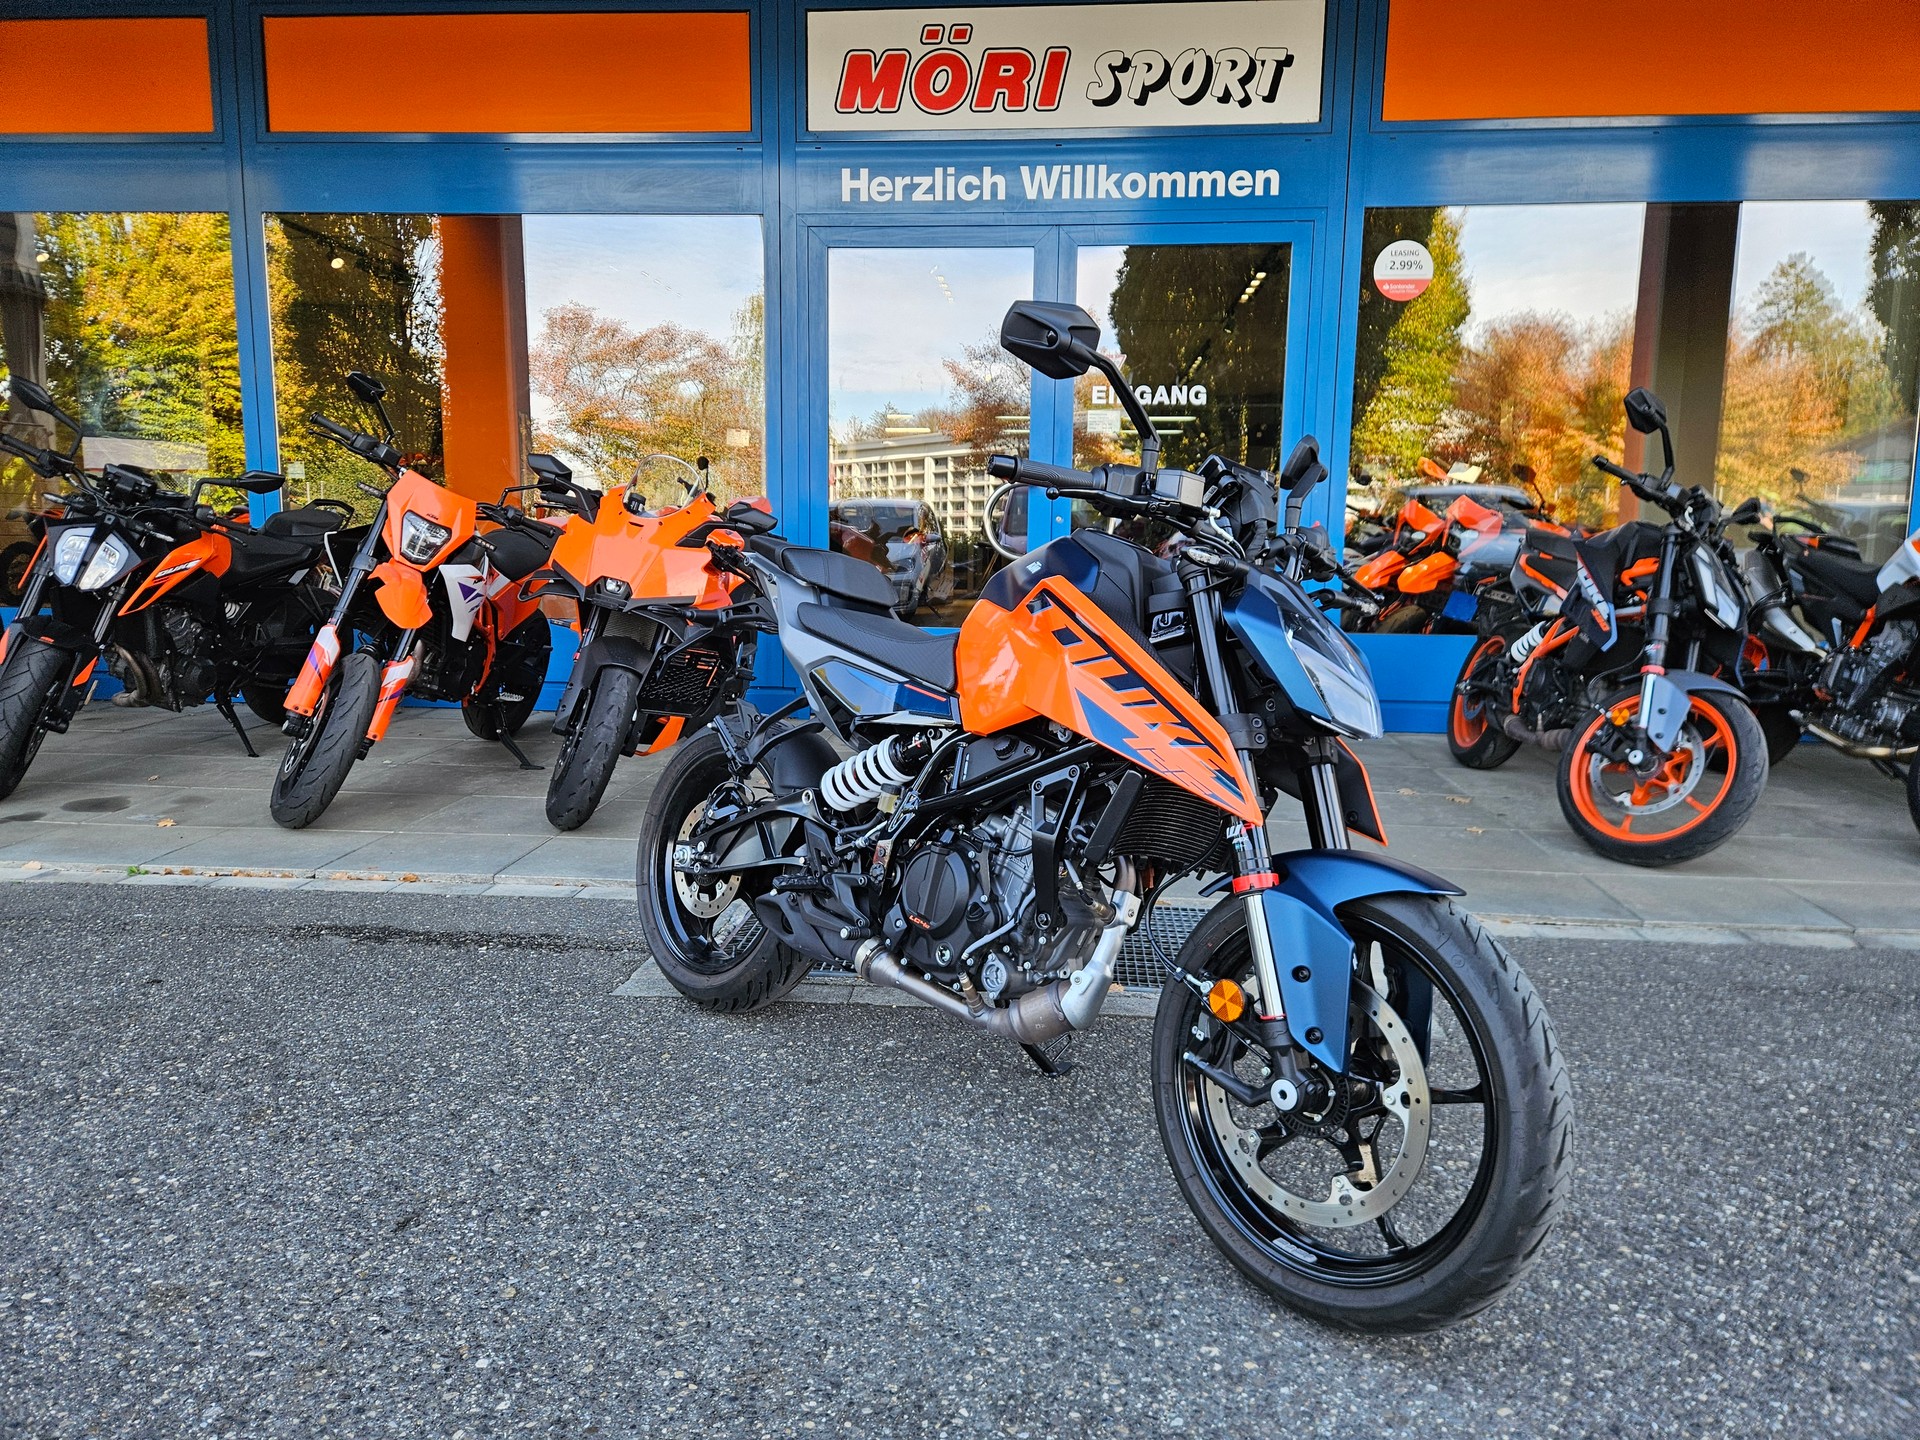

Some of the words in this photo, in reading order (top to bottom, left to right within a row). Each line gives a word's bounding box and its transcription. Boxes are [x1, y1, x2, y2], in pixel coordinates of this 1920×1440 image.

[835, 23, 1072, 115] MÖRI
[1086, 47, 1295, 108] SPORT
[841, 166, 1006, 202] Herzlich
[1020, 164, 1280, 200] Willkommen
[1389, 260, 1423, 270] 2.99%
[1091, 384, 1207, 406] EIGANG
[1030, 600, 1228, 772] DUKE
